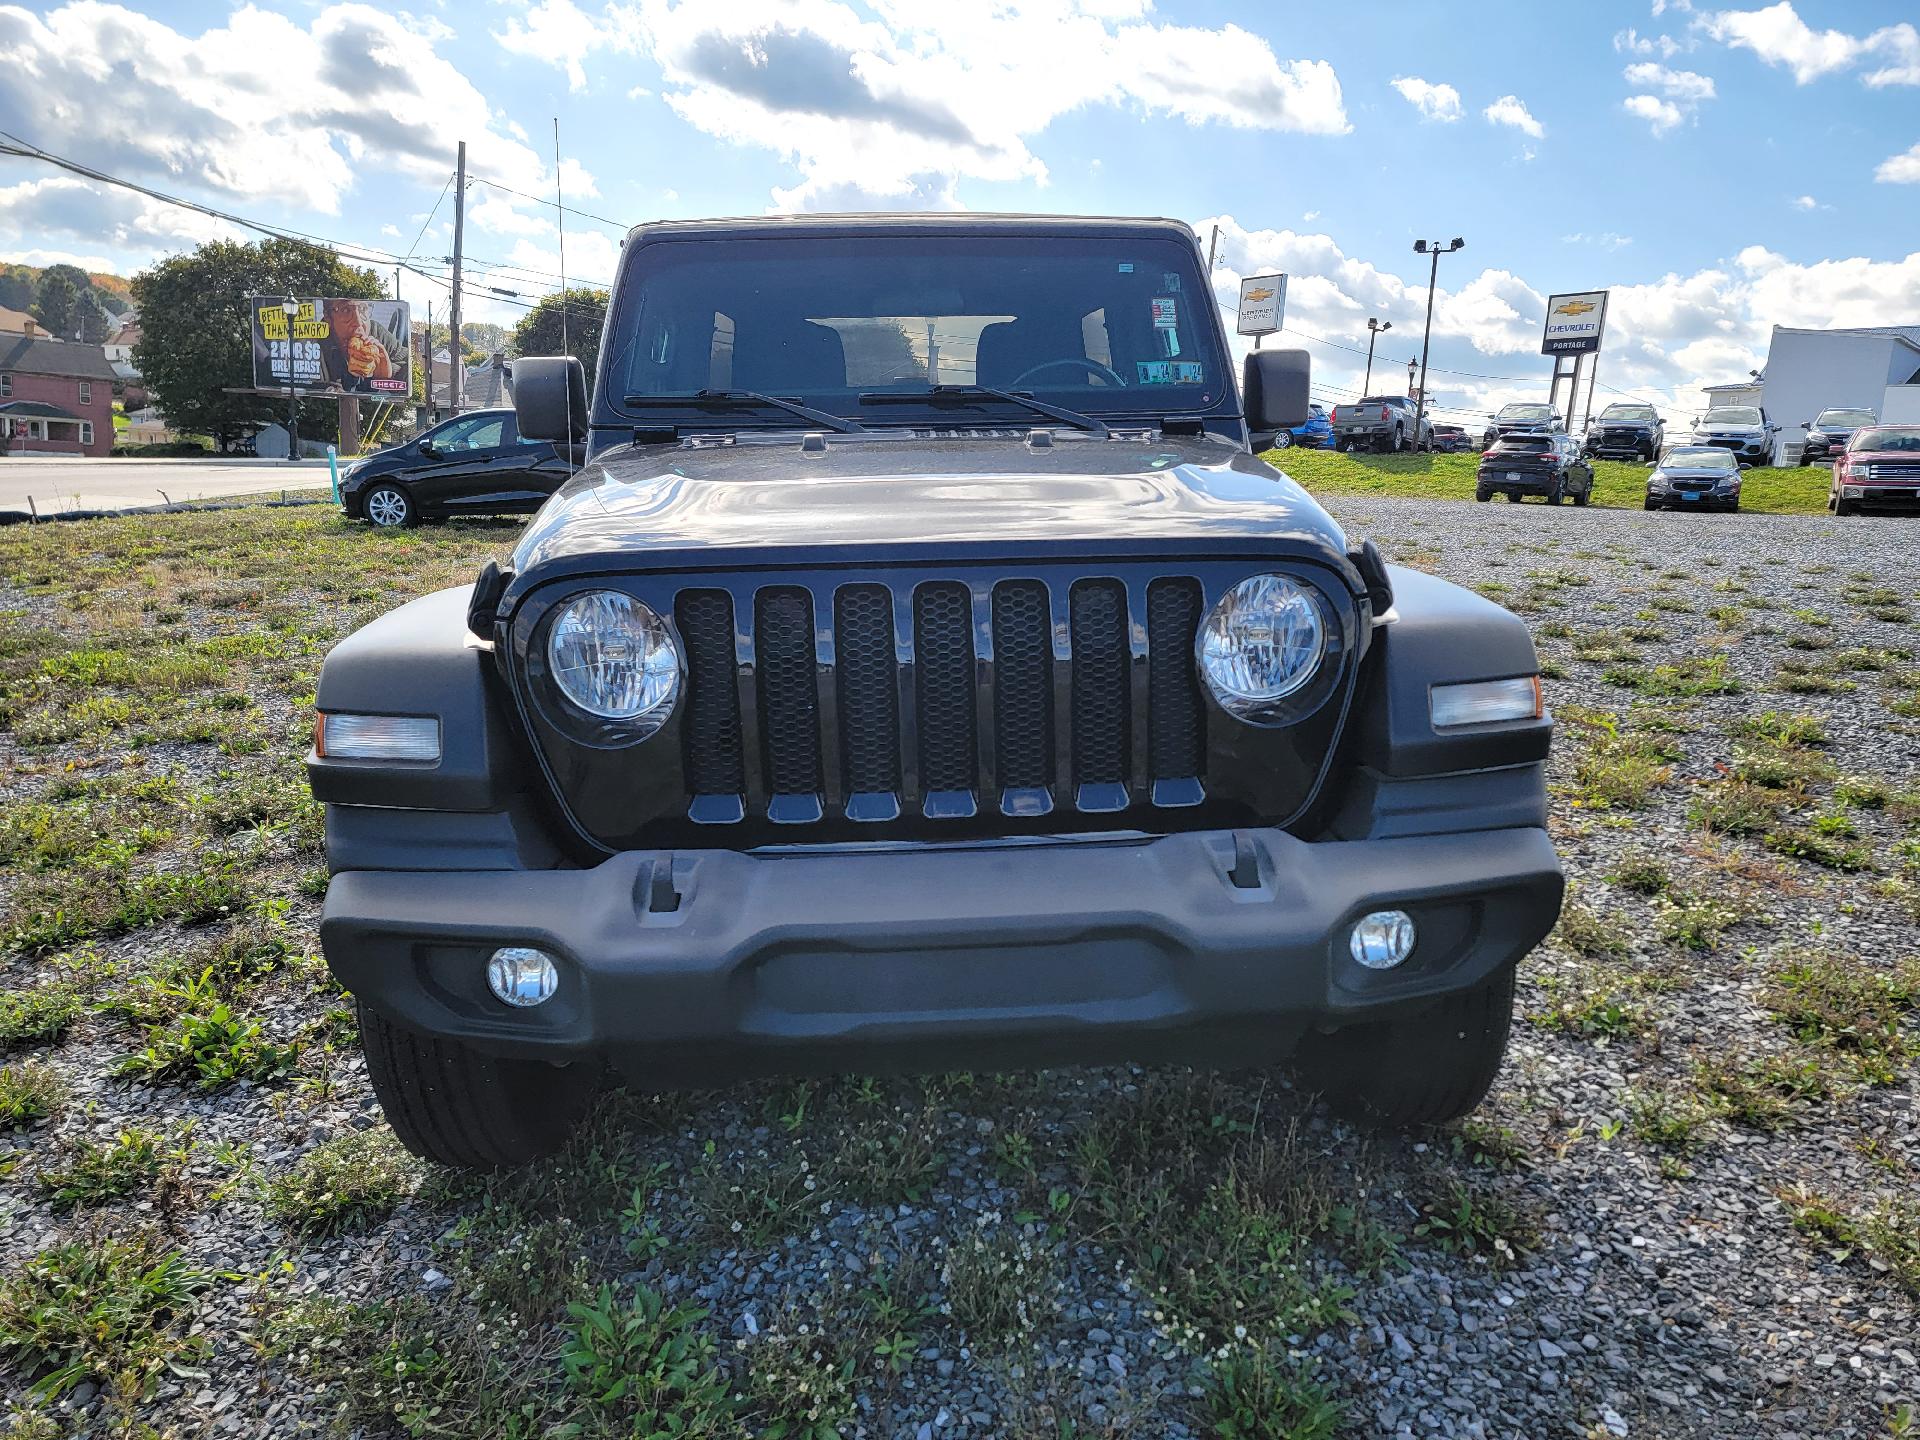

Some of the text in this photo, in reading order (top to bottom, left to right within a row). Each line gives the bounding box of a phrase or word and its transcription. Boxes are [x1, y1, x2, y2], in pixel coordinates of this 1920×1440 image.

[262, 305, 312, 322] BETTE ATE
[293, 323, 327, 337] HANGRY
[1548, 323, 1595, 333] CHEVROLET
[271, 342, 278, 357] 2
[305, 341, 321, 360] $6
[1553, 341, 1586, 349] PORTAGE
[271, 359, 321, 373] BREKFAST
[372, 381, 405, 389] SHEETZ
